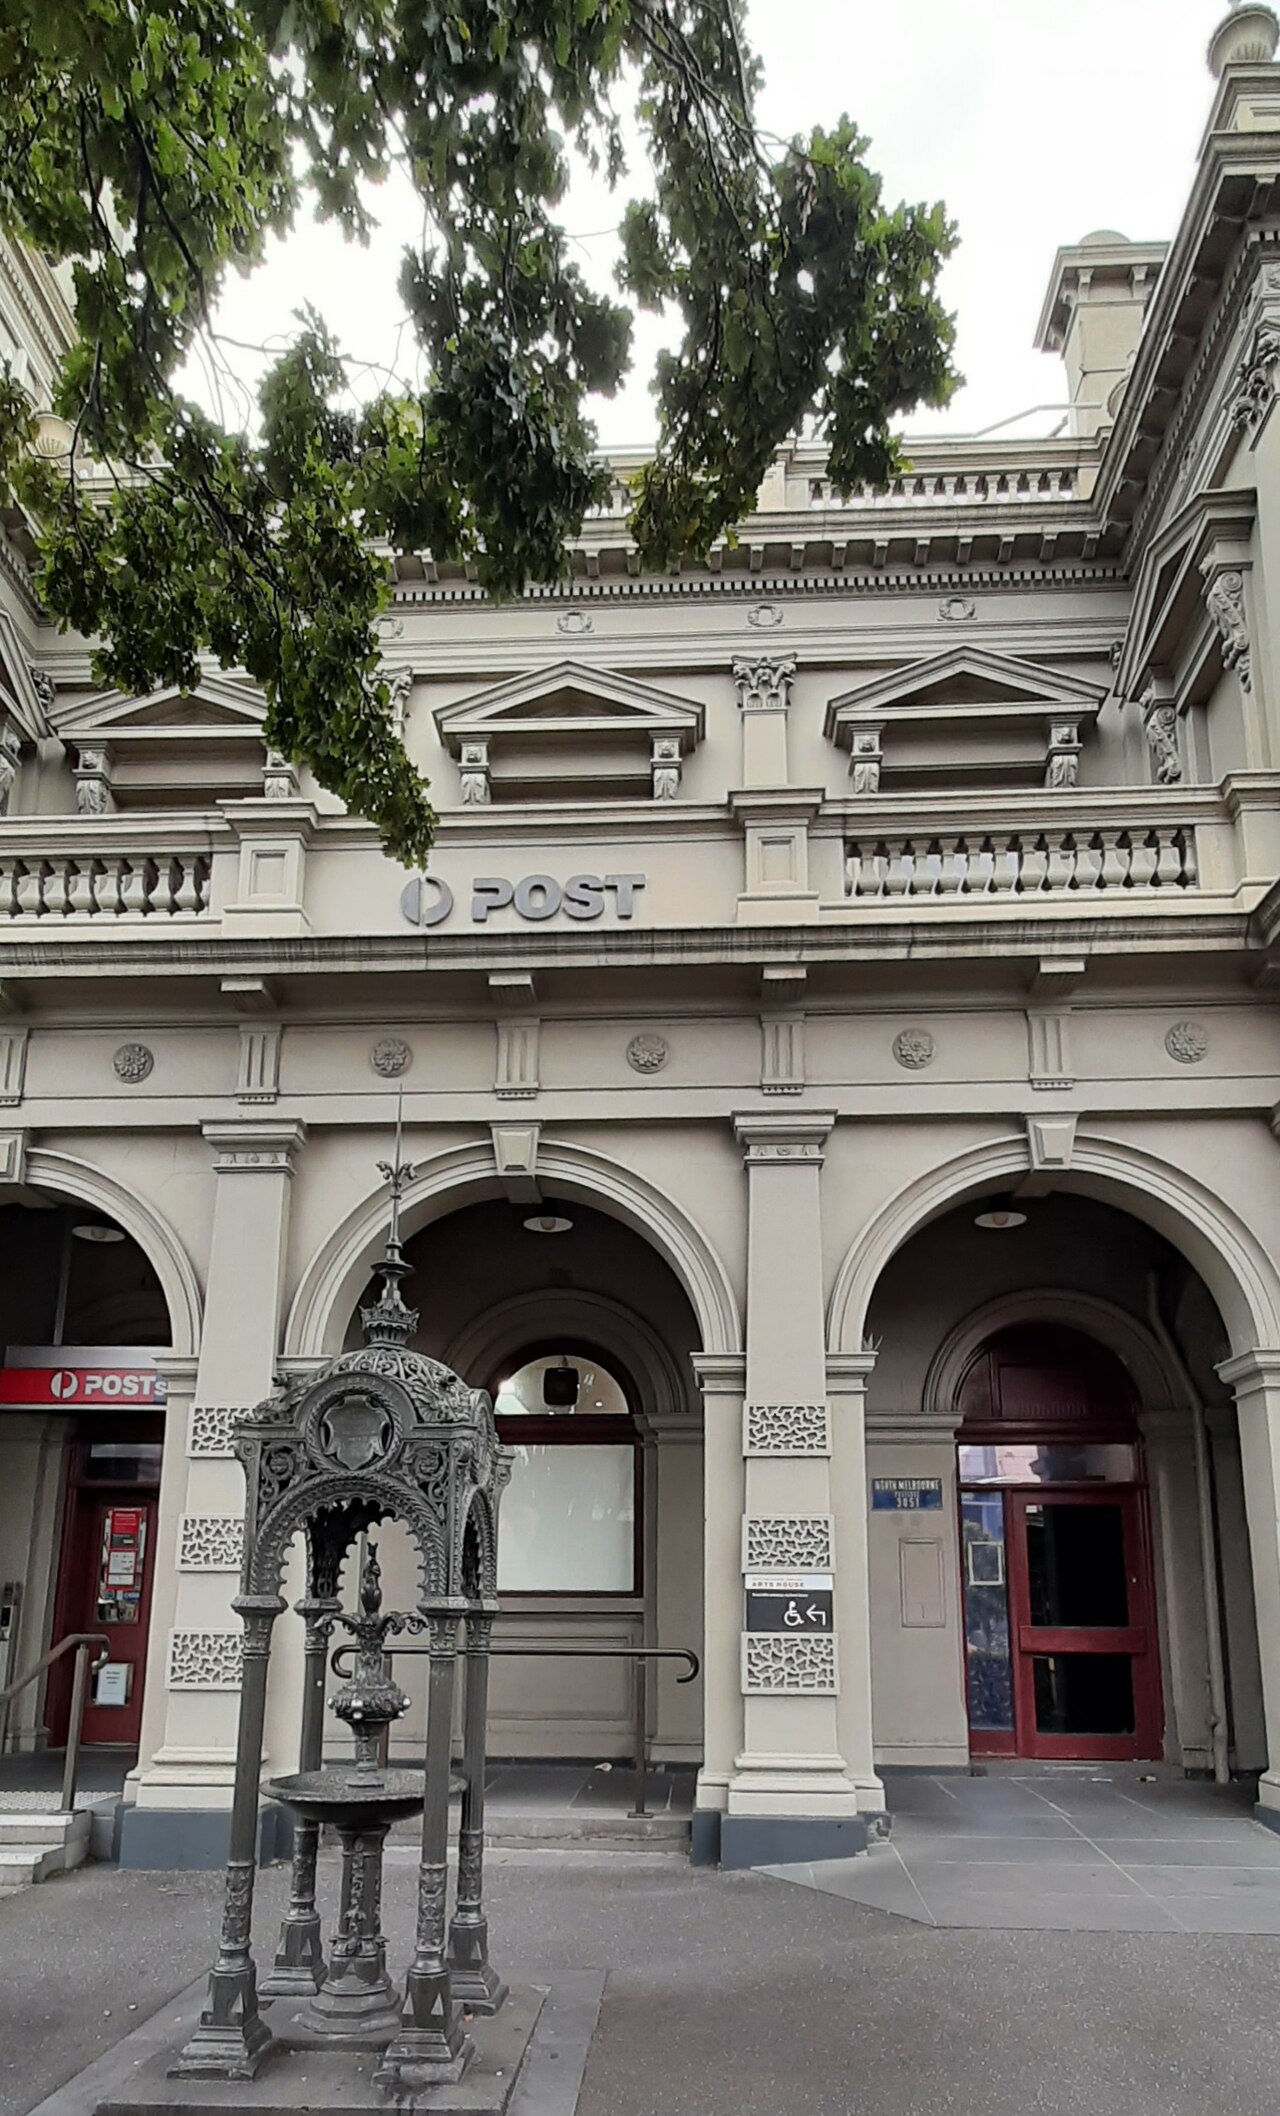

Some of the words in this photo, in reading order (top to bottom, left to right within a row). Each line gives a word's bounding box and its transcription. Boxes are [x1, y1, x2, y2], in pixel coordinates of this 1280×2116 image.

[472, 873, 646, 923] POST
[874, 1480, 897, 1490] NORTH
[898, 1480, 939, 1490] MELBOURNE
[896, 1497, 919, 1508] 3051
